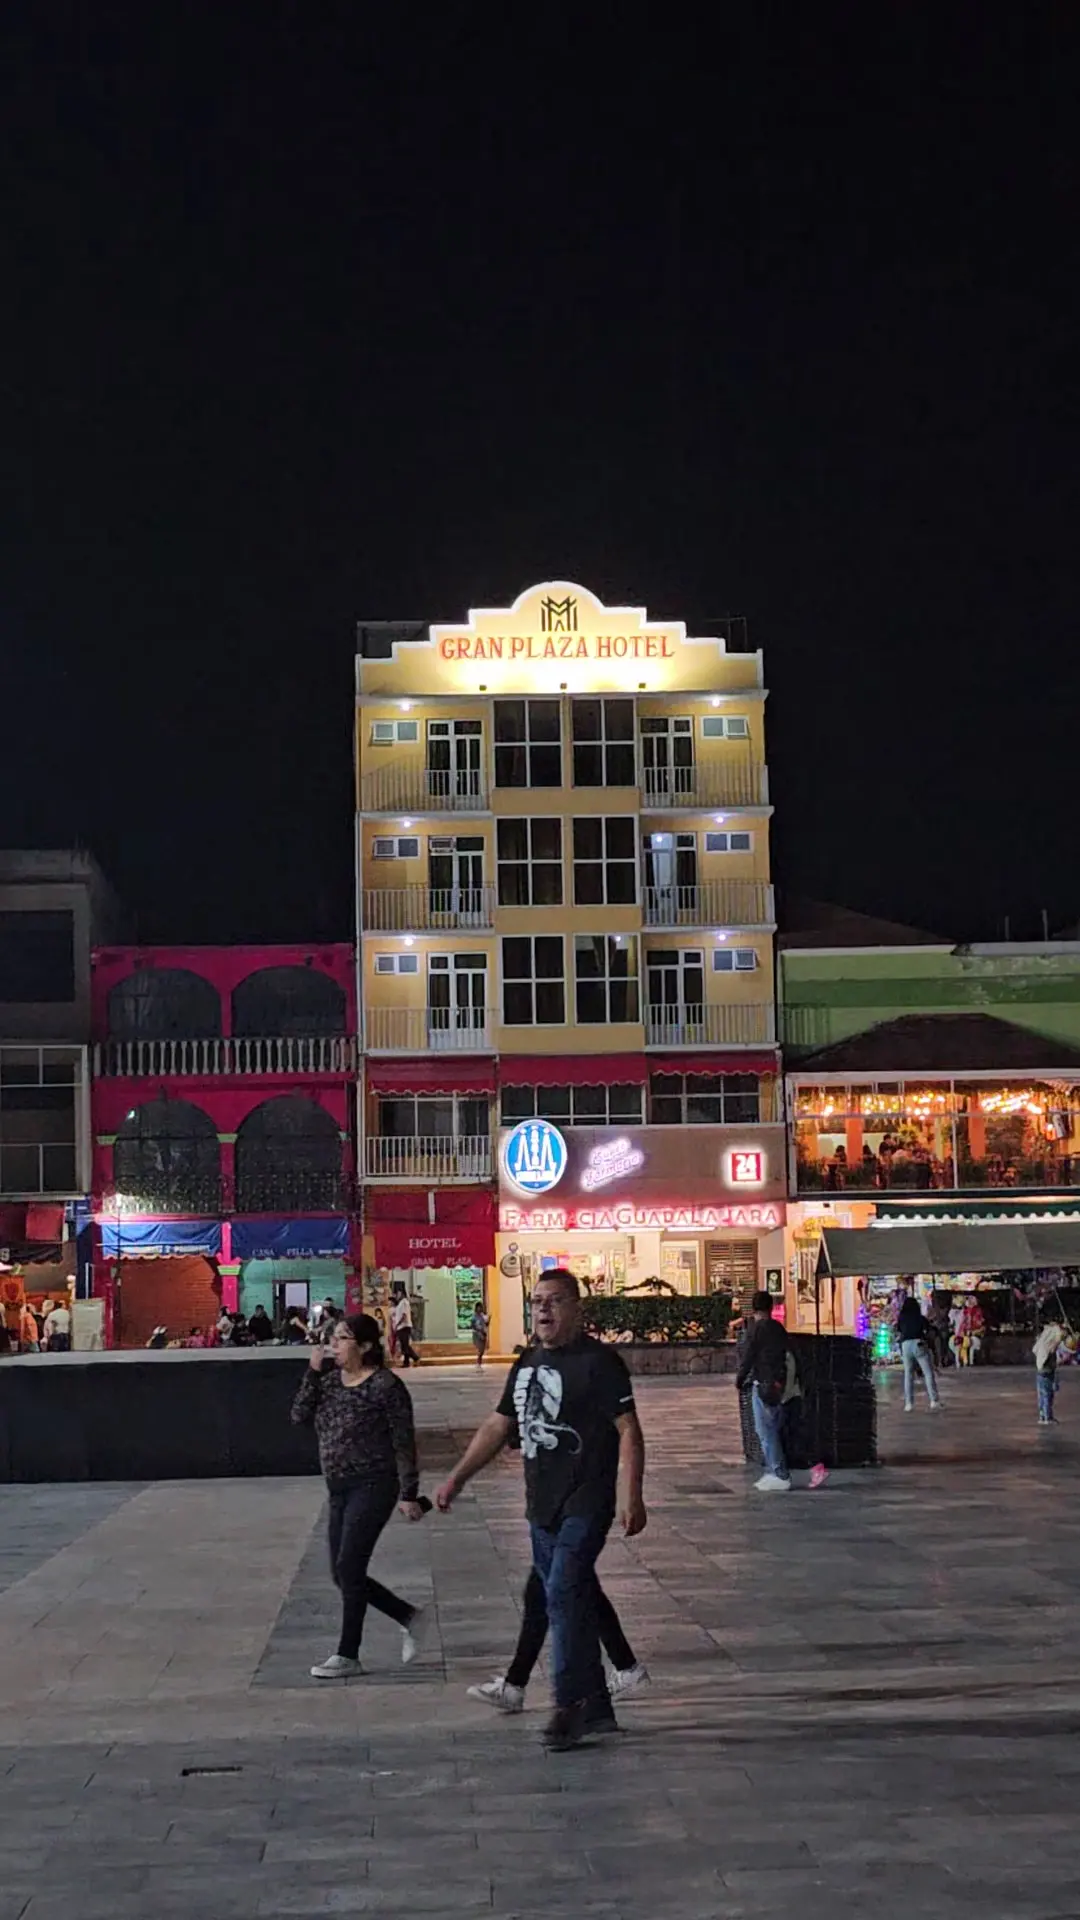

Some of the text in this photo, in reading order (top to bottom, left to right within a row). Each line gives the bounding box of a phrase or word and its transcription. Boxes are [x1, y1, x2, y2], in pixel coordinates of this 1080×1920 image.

[441, 635, 675, 660] GRAN PLAZA HOTEL
[735, 1154, 757, 1173] 24
[616, 1207, 777, 1225] GUADALAJARA
[408, 1237, 462, 1249] HOTEL
[411, 1256, 472, 1265] GRAN PLAZA
